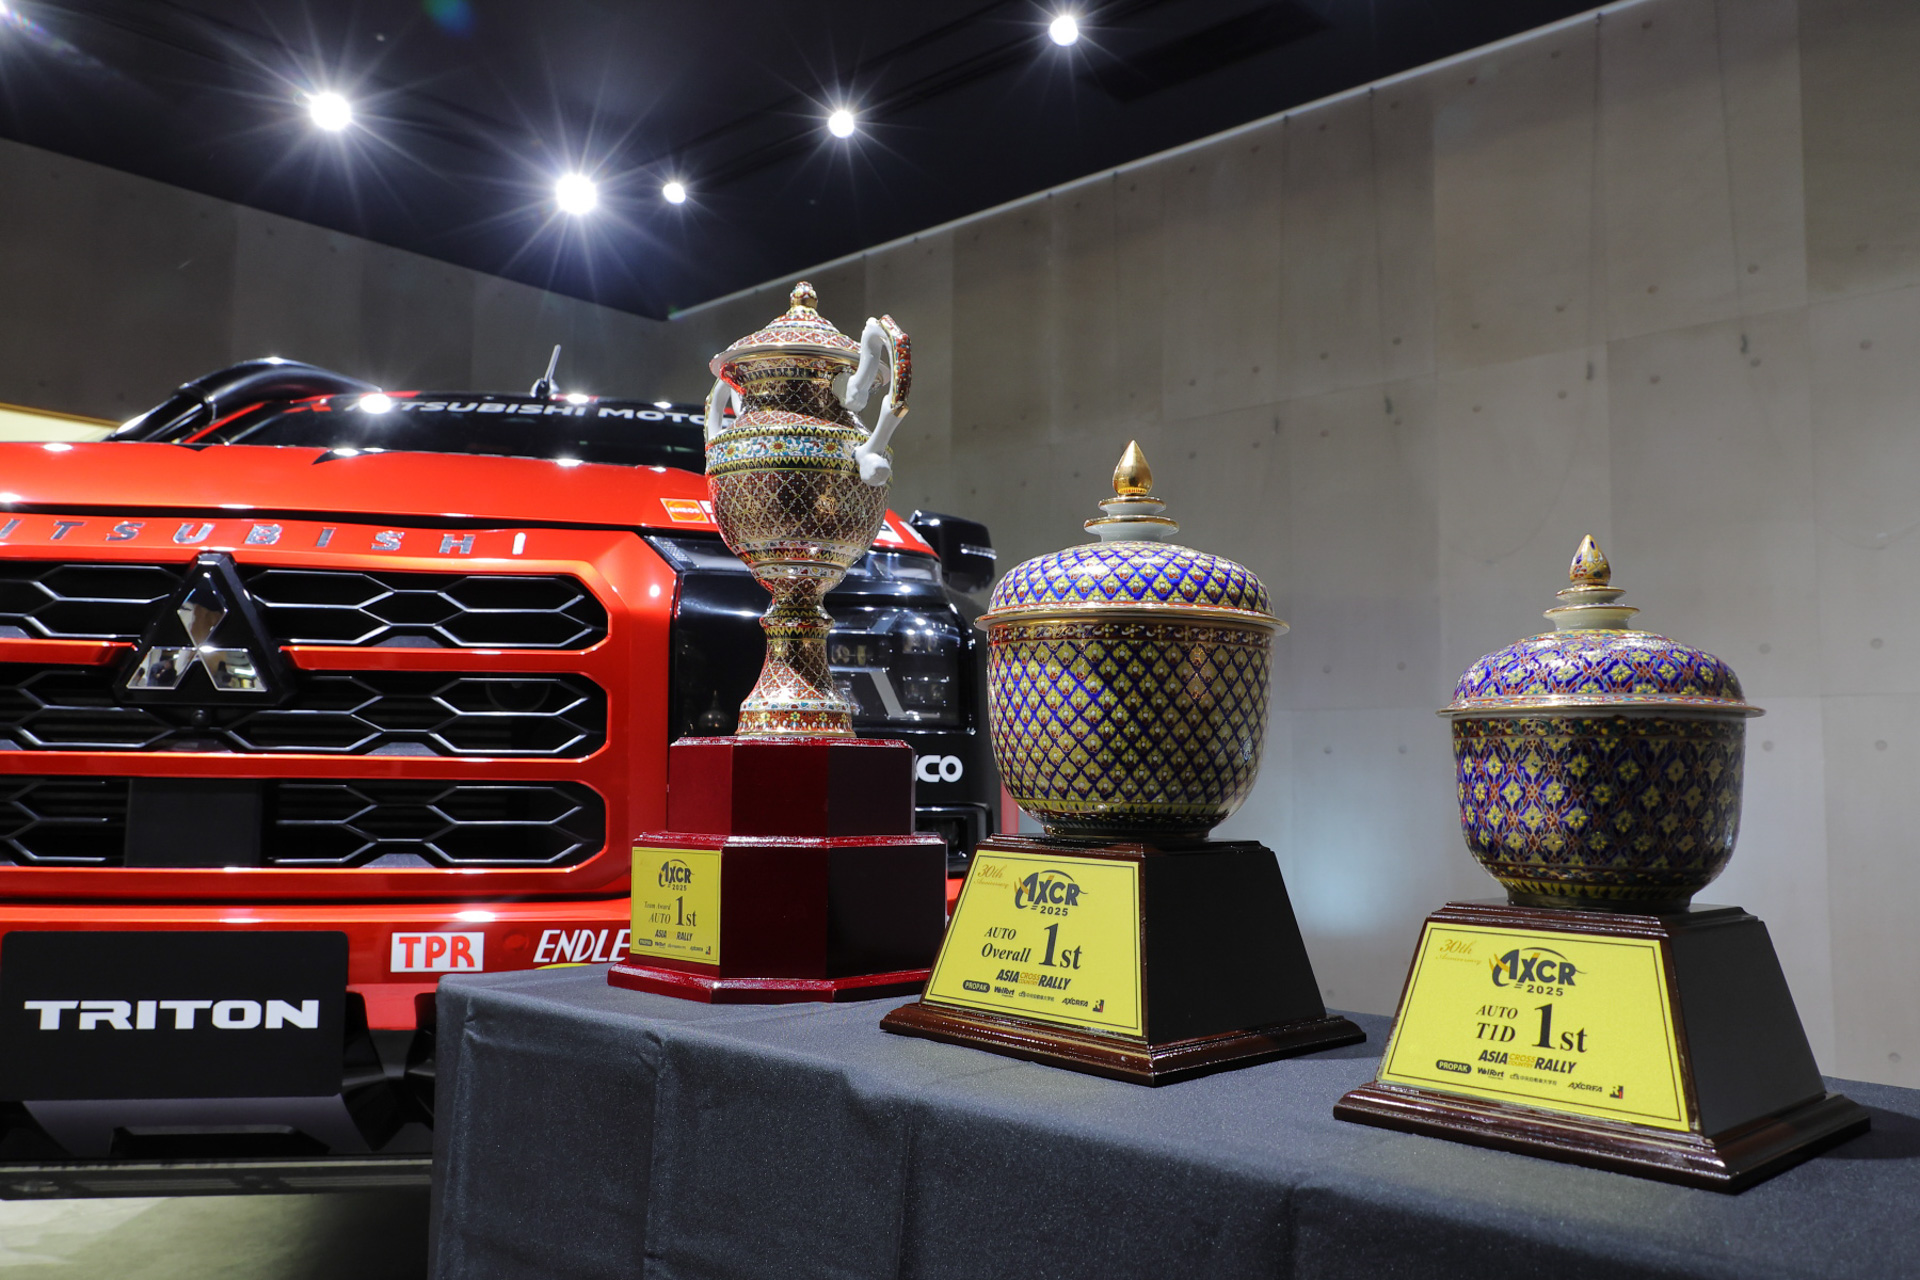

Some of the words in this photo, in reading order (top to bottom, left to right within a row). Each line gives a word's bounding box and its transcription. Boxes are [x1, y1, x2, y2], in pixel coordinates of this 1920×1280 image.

[916, 754, 963, 783] CO
[649, 913, 671, 924] AUTO
[675, 896, 697, 927] 1st
[1040, 905, 1069, 917] 2025
[655, 929, 667, 938] ASIA
[984, 926, 1017, 940] AUTO
[399, 935, 475, 969] TPR
[533, 929, 631, 963] ENDLE
[981, 942, 1032, 963] Overall
[1038, 922, 1083, 970] 1st
[996, 969, 1020, 983] ASIA
[1038, 974, 1072, 990] RALLY
[1526, 984, 1564, 997] 2025
[24, 1000, 319, 1030] TRITON
[1475, 1005, 1519, 1020] AUTO
[1475, 1022, 1516, 1043] T1D
[1531, 1002, 1588, 1053] 1st
[1438, 1061, 1469, 1073] PROPAK
[1478, 1050, 1509, 1065] ASIA
[1508, 1053, 1536, 1063] CROSS
[1534, 1057, 1577, 1074] RALLY
